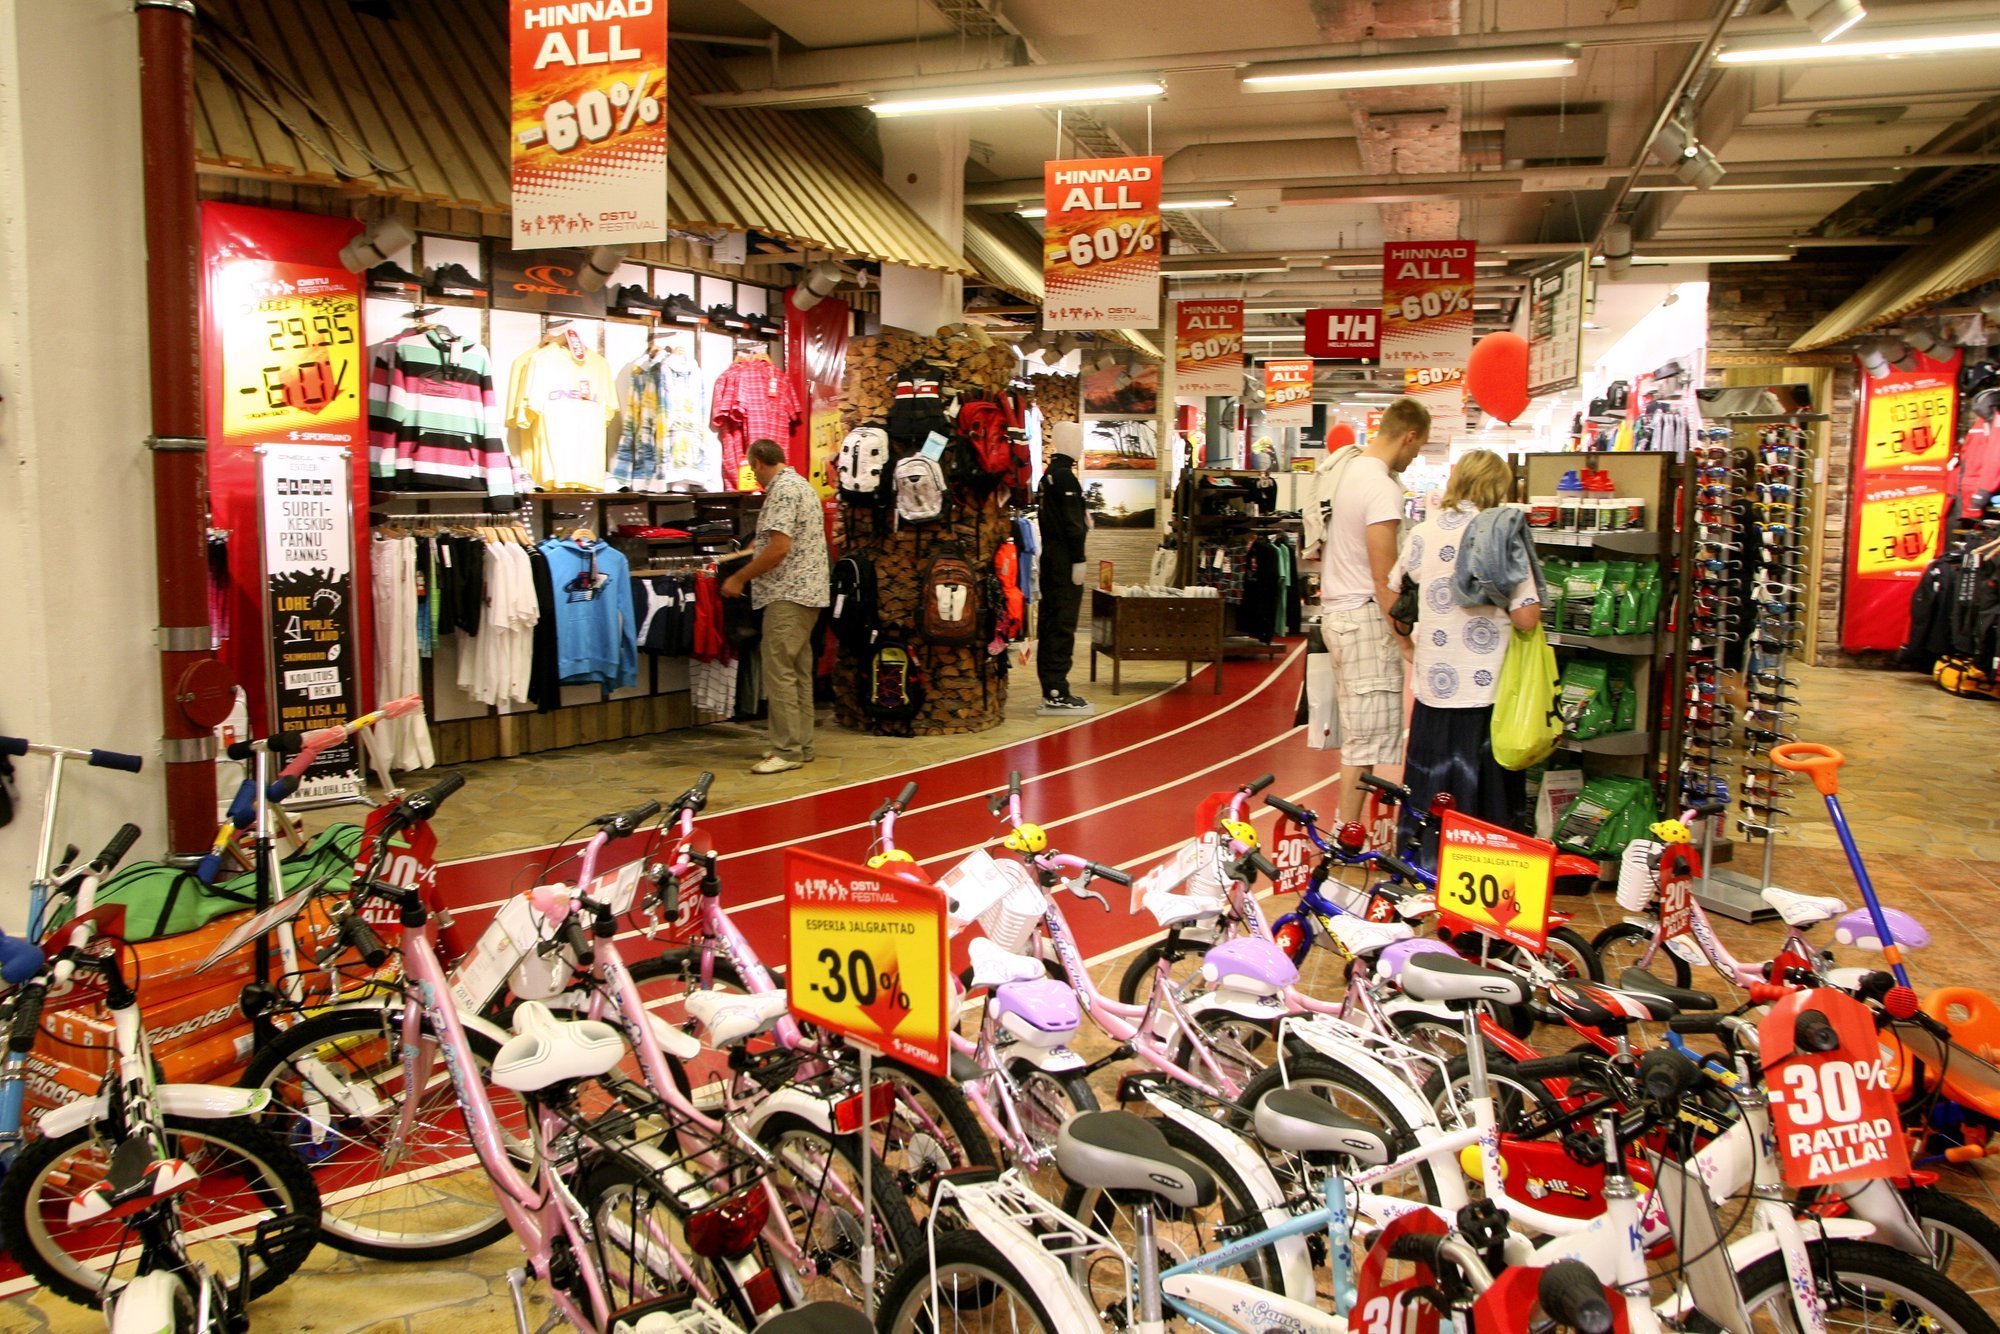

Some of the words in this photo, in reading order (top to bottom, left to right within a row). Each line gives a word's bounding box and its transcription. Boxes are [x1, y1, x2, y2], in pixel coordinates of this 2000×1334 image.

[524, 0, 653, 29] HINNAD
[533, 25, 641, 70] ALL
[518, 73, 660, 152] -60%
[1055, 167, 1151, 185] HINNAD
[1060, 185, 1142, 212] ALL
[599, 210, 637, 222] OSTU
[599, 221, 659, 232] FESTIVAL
[1048, 218, 1155, 267] -60%
[1391, 247, 1468, 260] HINNAD
[1396, 261, 1460, 280] ALL
[297, 277, 329, 287] OSTU
[1183, 305, 1239, 315] HINNAD
[1387, 285, 1470, 321] -60%
[1186, 315, 1233, 330] ALL
[1328, 315, 1376, 341] HH
[1181, 335, 1240, 361] -60%
[1268, 364, 1309, 372] HINNAD
[1271, 371, 1305, 382] ALL
[1269, 385, 1311, 404] -60%
[282, 501, 331, 517] SURFI-
[287, 517, 334, 531] KESKUS
[285, 548, 329, 562] RANNAS
[277, 596, 312, 611] LOHE
[289, 670, 334, 685] KOOLITUS
[313, 684, 337, 697] RENT
[1451, 852, 1481, 863] ESPERIA
[1482, 857, 1530, 869] JALGRATTAD
[850, 880, 880, 892] OSTU
[1450, 871, 1521, 913] -30%
[850, 891, 899, 904] FESTIVAL
[806, 918, 846, 932] ESPERIA
[849, 921, 915, 935] JALGRATTAD
[810, 947, 911, 1011] -30%
[1768, 1058, 1892, 1126] -30%
[1788, 1118, 1893, 1158] RATTAD
[1808, 1139, 1889, 1181] ALLA!
